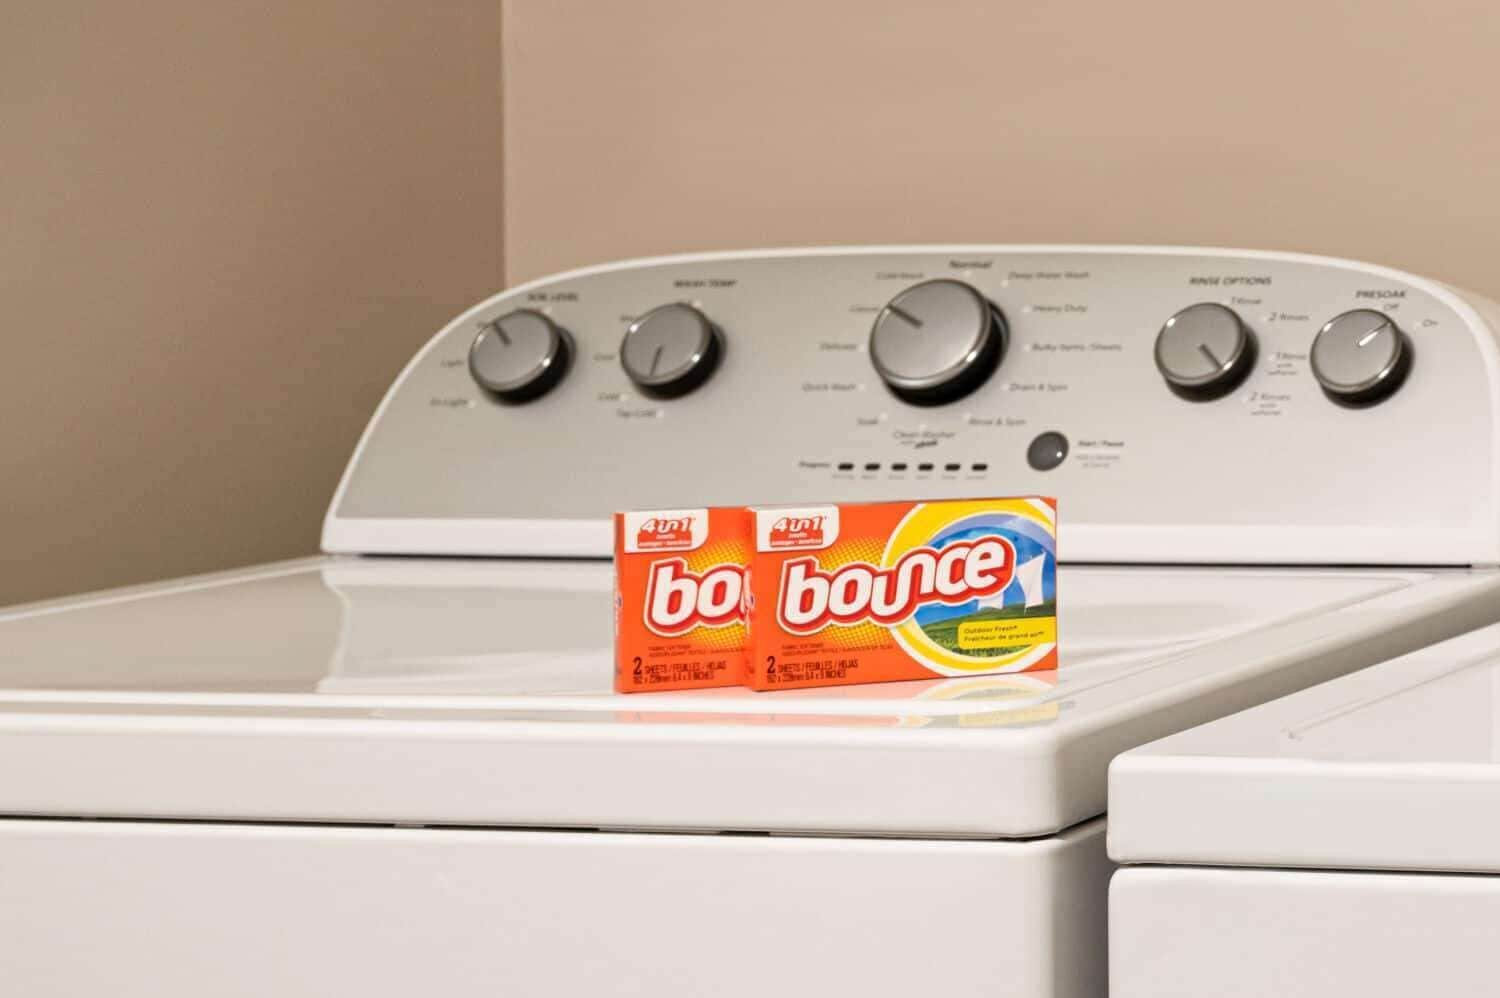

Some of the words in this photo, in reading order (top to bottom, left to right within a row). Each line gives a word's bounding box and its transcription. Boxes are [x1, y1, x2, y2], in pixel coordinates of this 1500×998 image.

[1222, 276, 1272, 286] OPTIONS
[1355, 290, 1406, 299] PRESOAK
[779, 538, 1013, 633] bounce
[633, 656, 643, 675] 2
[766, 655, 776, 674] 2
